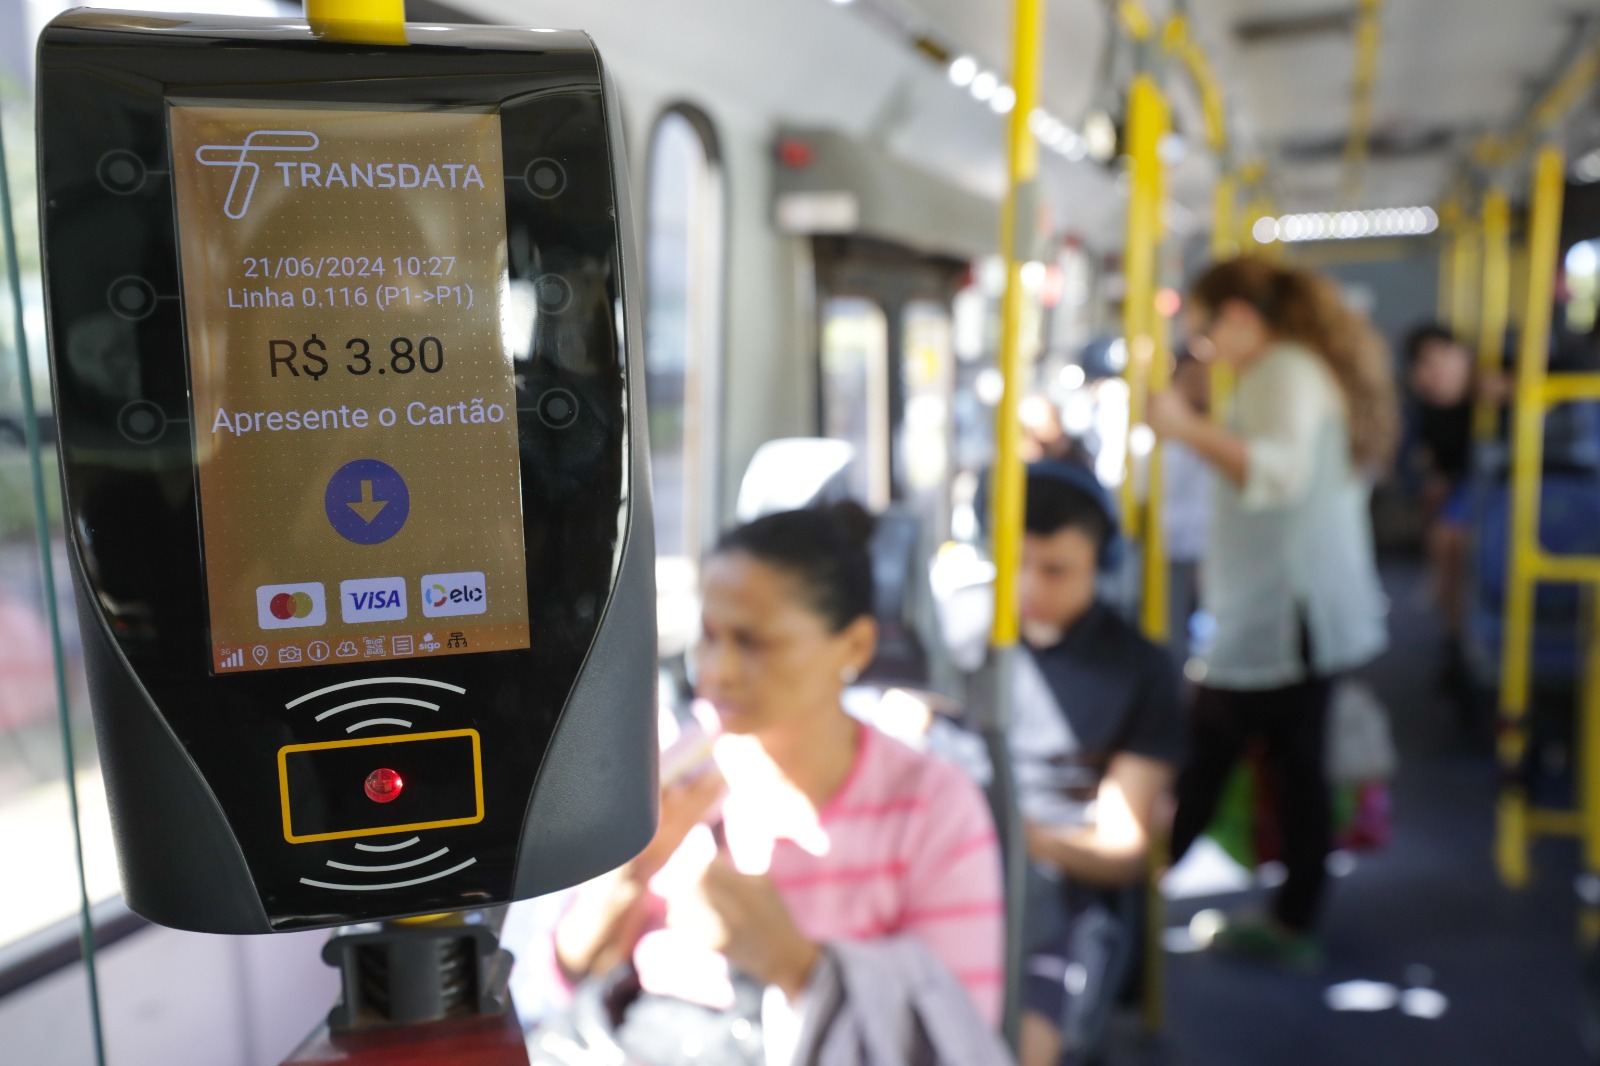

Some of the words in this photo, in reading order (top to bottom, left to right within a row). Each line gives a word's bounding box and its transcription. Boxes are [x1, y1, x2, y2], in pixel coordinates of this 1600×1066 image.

[275, 161, 485, 189] TRANSDATA
[242, 256, 385, 279] 21/06/2024
[393, 256, 456, 277] 10:27
[228, 287, 295, 308] Linha
[375, 283, 474, 311] (P1->P1)
[268, 334, 329, 381] R$
[345, 336, 444, 375] 3.80
[211, 407, 369, 437] Apresente
[378, 408, 397, 428] o
[407, 398, 504, 427] Cartão
[348, 590, 401, 611] VISA
[449, 586, 483, 604] elo
[418, 641, 441, 652] sigo
